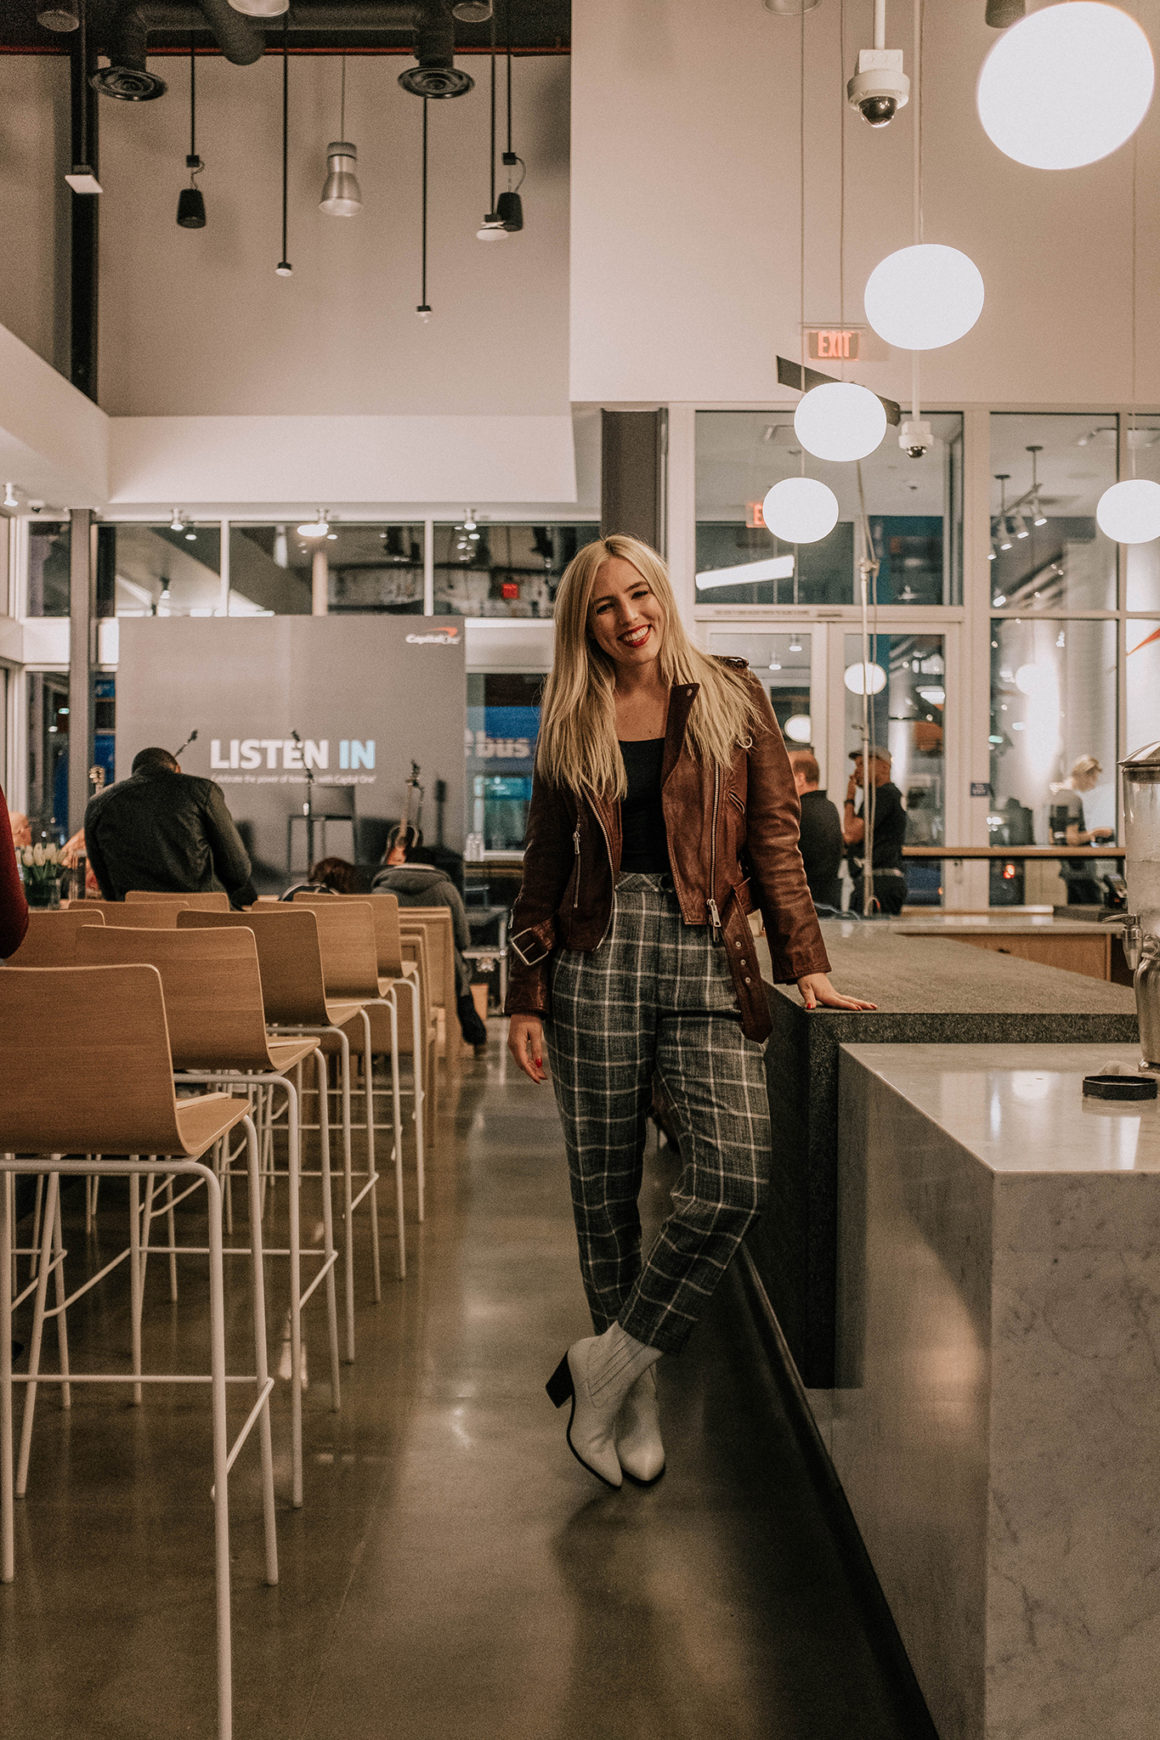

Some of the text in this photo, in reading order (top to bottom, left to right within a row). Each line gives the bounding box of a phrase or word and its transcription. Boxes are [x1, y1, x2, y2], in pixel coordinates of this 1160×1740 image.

[817, 332, 852, 358] EXIT
[210, 739, 376, 770] LISTEN IN
[475, 730, 530, 759] bus
